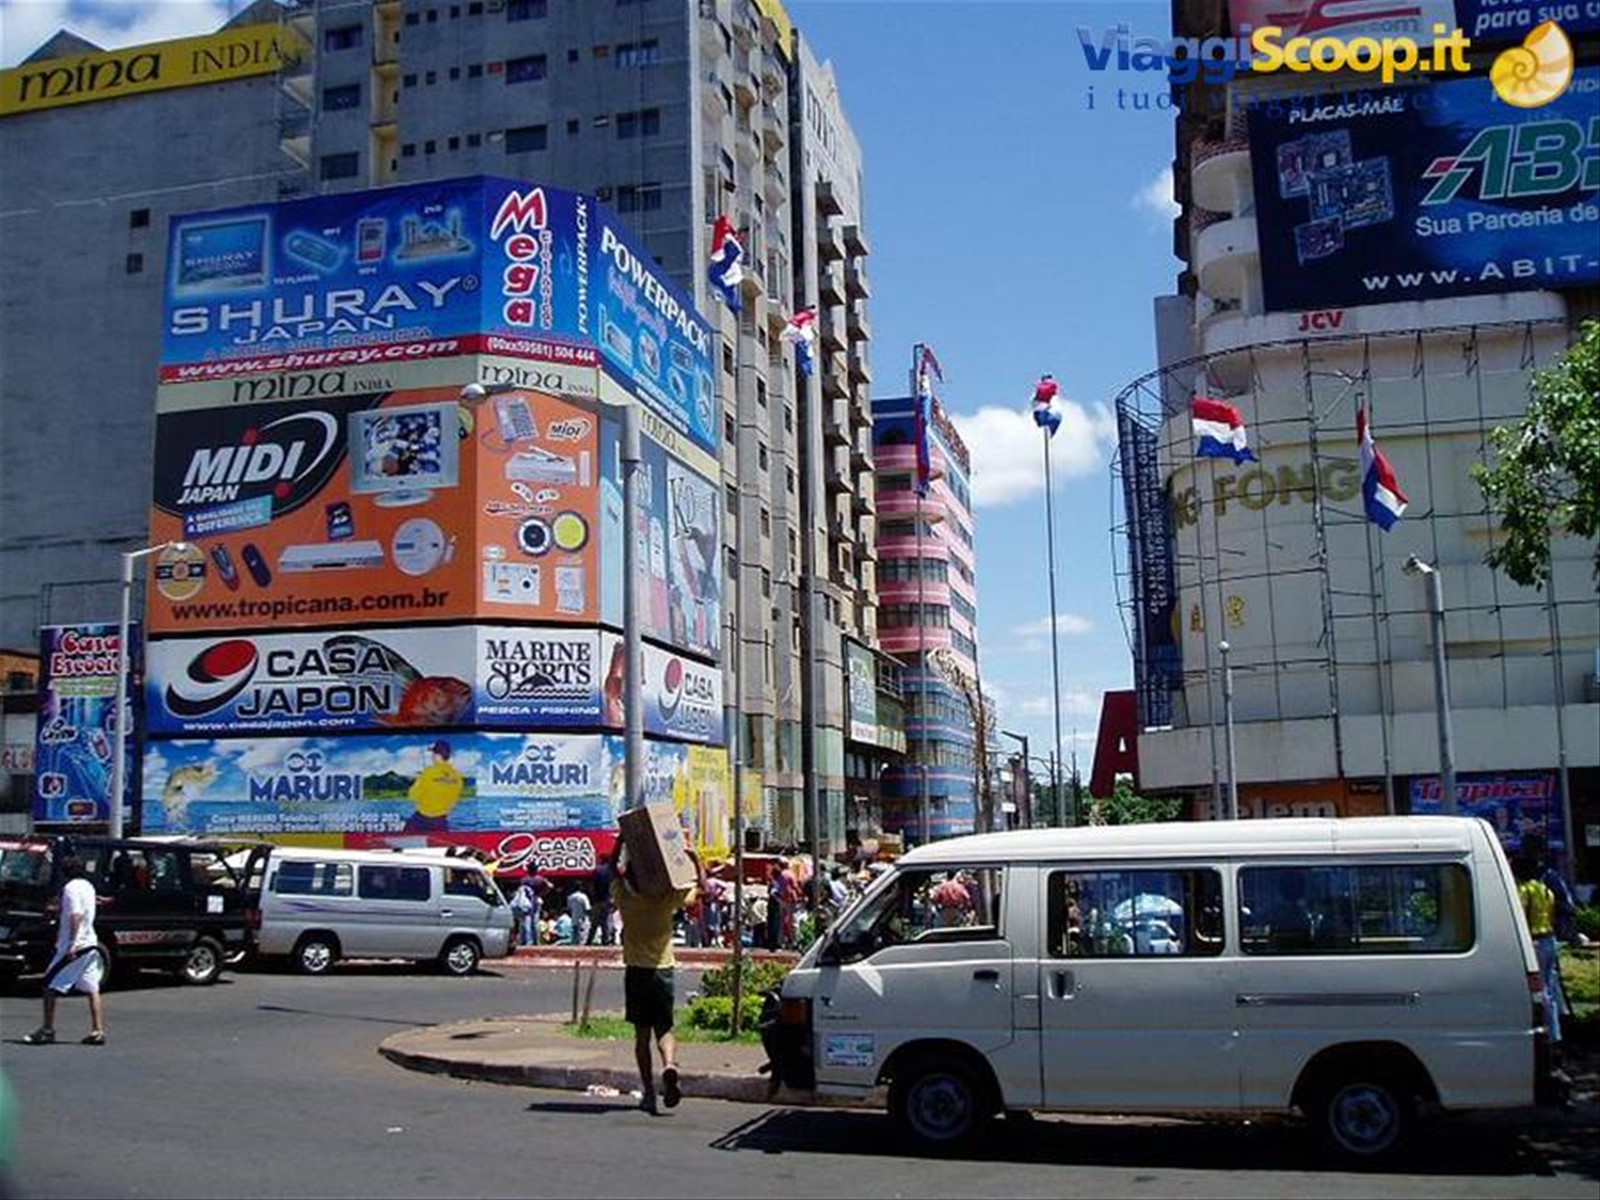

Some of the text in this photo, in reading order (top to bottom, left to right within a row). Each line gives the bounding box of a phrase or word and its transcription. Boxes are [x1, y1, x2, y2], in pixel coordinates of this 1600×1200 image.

[1475, 9, 1530, 36] para
[1539, 5, 1579, 22] sua
[192, 39, 284, 75] INDIA
[1290, 97, 1403, 124] PLACAS-MÃE
[1416, 202, 1599, 237] Sua Parceria de
[489, 187, 547, 327] Mega
[576, 196, 588, 334] POWERPACK
[171, 277, 461, 335] SHURAY
[601, 226, 709, 357] POWERPACK
[233, 314, 394, 345] JAPAN
[1297, 311, 1344, 331] JCV
[178, 340, 458, 378] www.shuray.com
[233, 370, 348, 403] mina
[482, 364, 563, 390] mina
[182, 437, 306, 487] MIDI
[177, 485, 240, 505] JAPAN
[1213, 461, 1362, 517] FONG
[172, 587, 449, 620] www.tropicana.com.br
[265, 647, 392, 678] CASA
[485, 639, 591, 662] MARINE
[486, 661, 591, 700] SPORTS
[684, 672, 715, 701] CASA
[237, 683, 391, 718] JAPON
[183, 717, 356, 731] www.casajapon.com
[250, 773, 364, 801] MARURI
[492, 762, 589, 786] MARURI
[537, 837, 595, 853] CASA
[530, 855, 595, 871] APON
